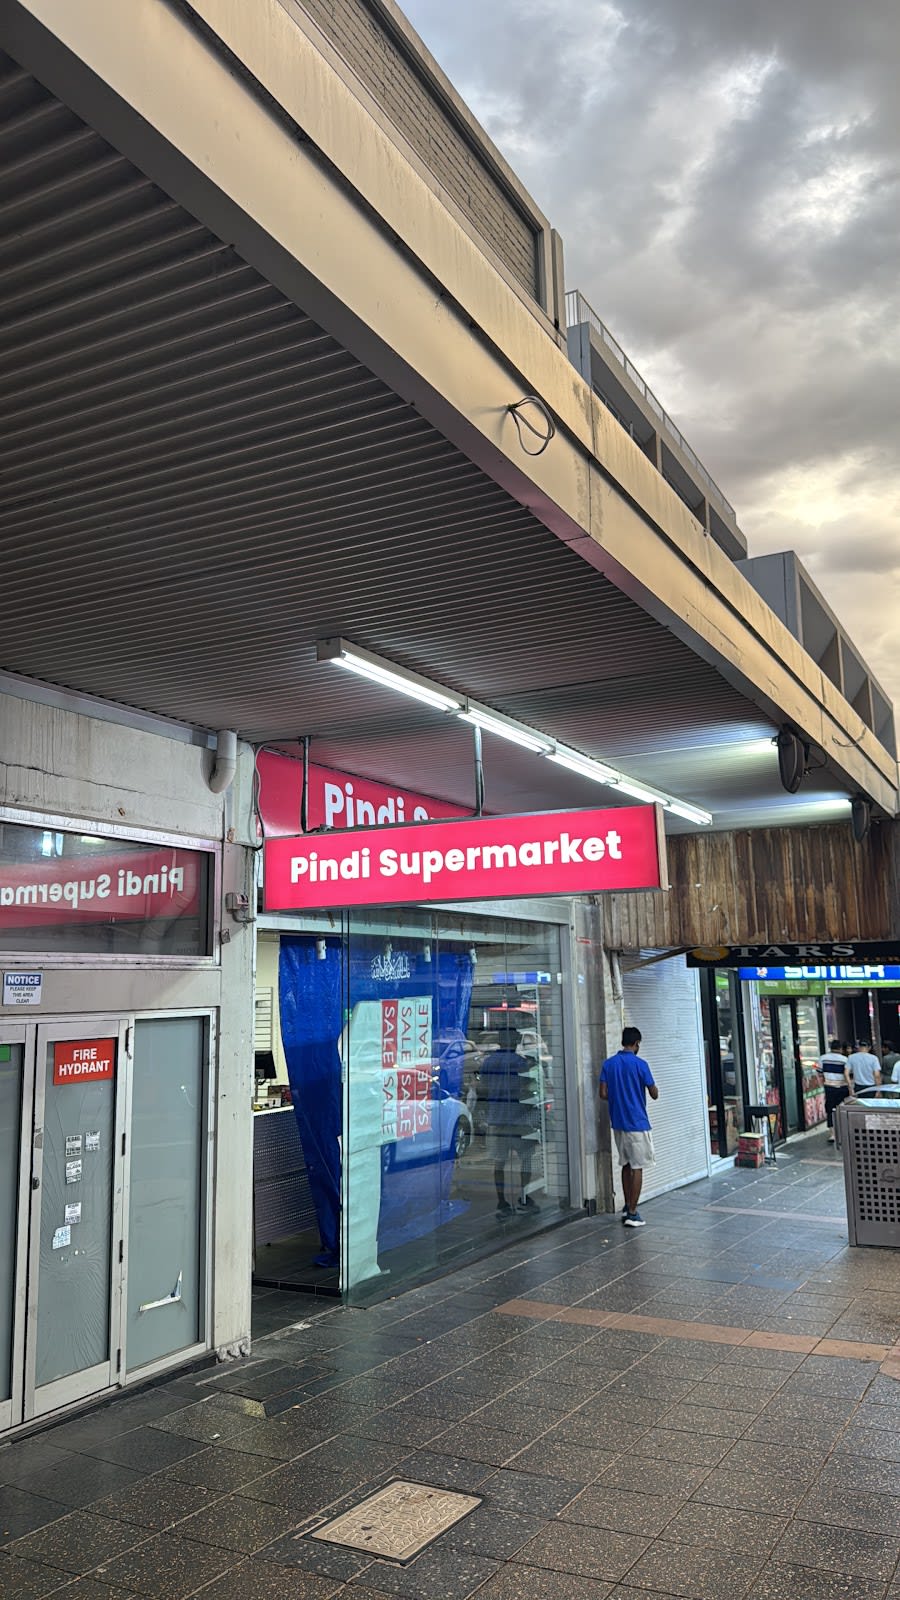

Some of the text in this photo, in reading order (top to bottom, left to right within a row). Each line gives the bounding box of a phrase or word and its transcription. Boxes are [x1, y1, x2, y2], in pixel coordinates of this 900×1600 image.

[325, 782, 405, 827] Pindi
[290, 830, 622, 883] Pindi Supermarket
[8, 976, 39, 984] NOTICE
[73, 1048, 97, 1061] FIRE
[382, 1006, 395, 1063] SALE
[401, 1006, 412, 1063] SALE
[418, 1003, 428, 1058] SALE
[59, 1060, 110, 1076] HYDRANT
[382, 1076, 394, 1136] SALE
[400, 1074, 411, 1137] SALE
[418, 1067, 429, 1125] SALE
